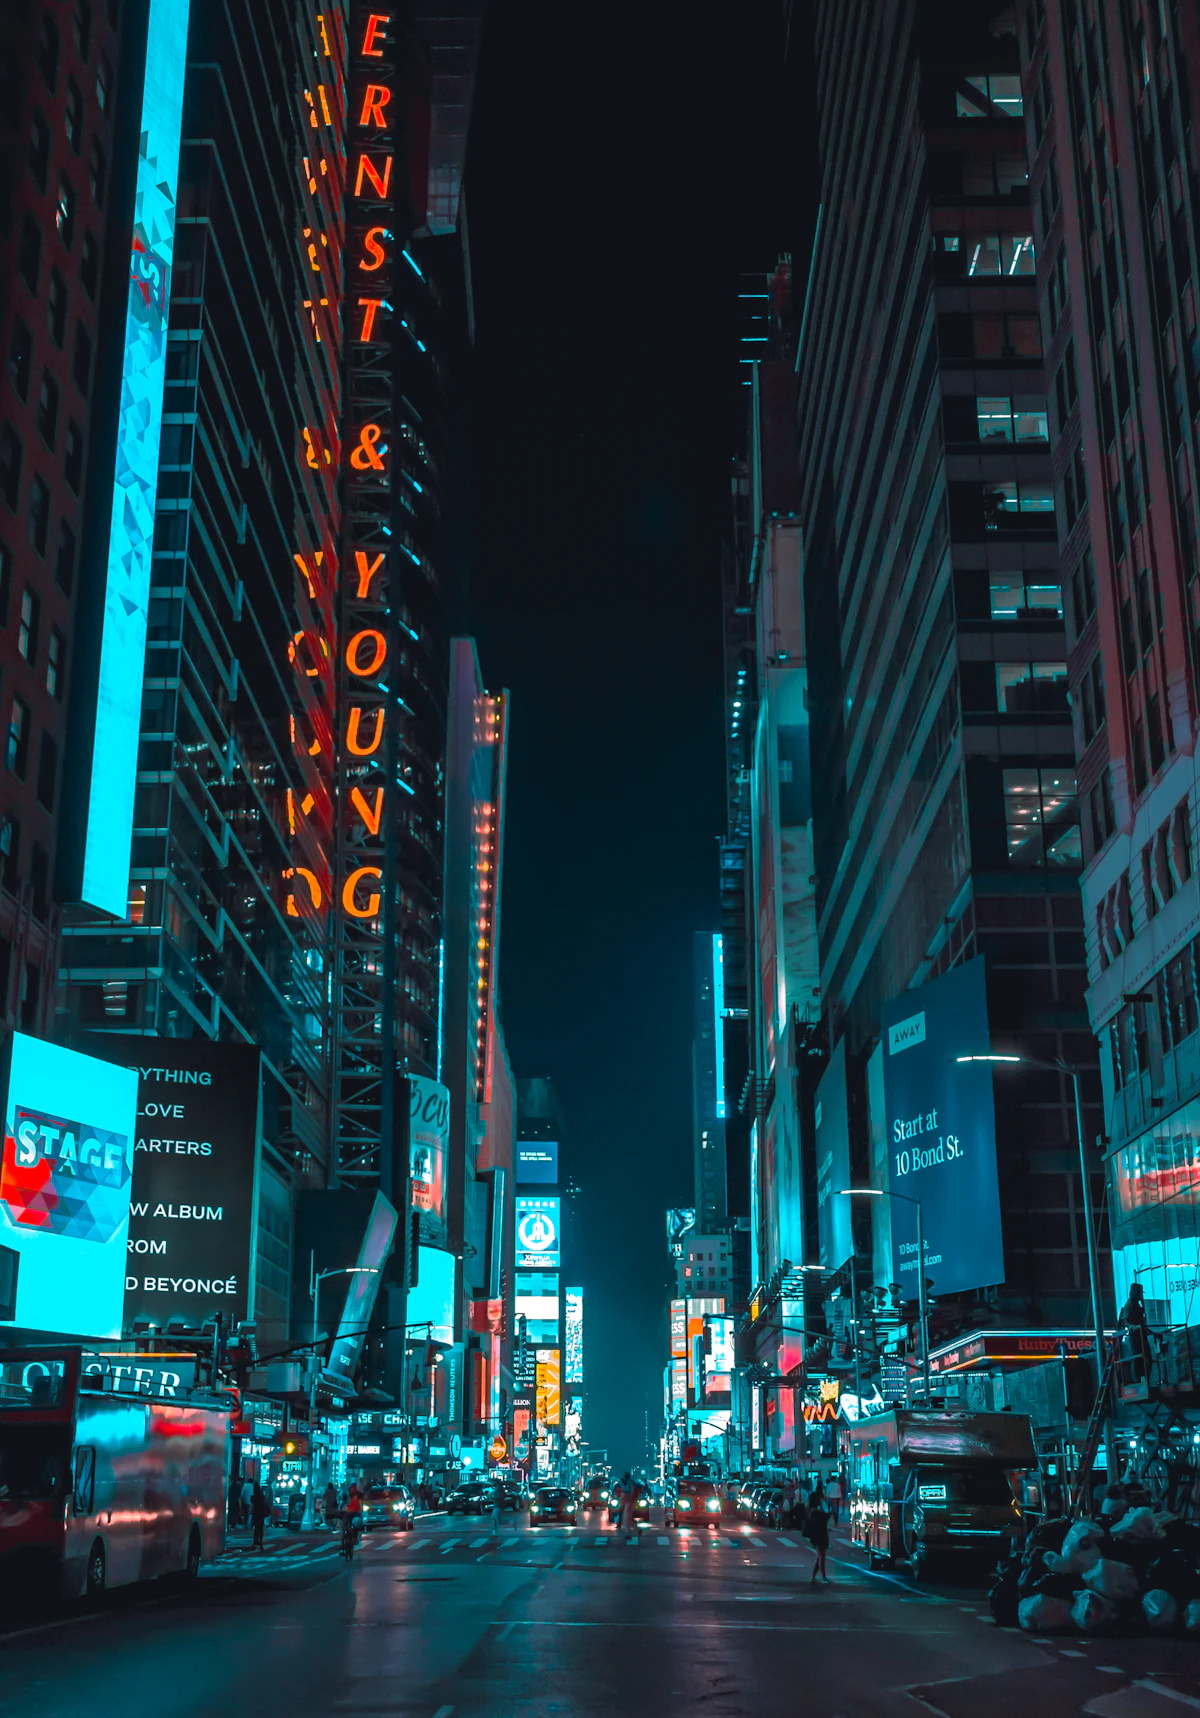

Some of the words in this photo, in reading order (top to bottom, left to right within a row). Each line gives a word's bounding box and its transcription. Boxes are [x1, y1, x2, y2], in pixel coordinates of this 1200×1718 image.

[354, 14, 393, 343] ERNST
[350, 423, 388, 470] &
[342, 551, 387, 918] YOUNG
[894, 1021, 922, 1045] AWAY
[893, 1113, 924, 1143] Start
[925, 1108, 938, 1131] at
[18, 1120, 123, 1175] STAGE
[134, 1138, 212, 1156] ARTERS
[895, 1151, 910, 1177] 10
[912, 1143, 945, 1172] Bond
[946, 1134, 964, 1161] St.
[153, 1204, 223, 1220] ALBUM
[127, 1239, 167, 1254] ROM
[144, 1275, 237, 1294] BEYONCÉ
[1018, 1338, 1056, 1352] Ruby
[1056, 1337, 1114, 1351] Tues
[446, 1460, 462, 1470] CASE
